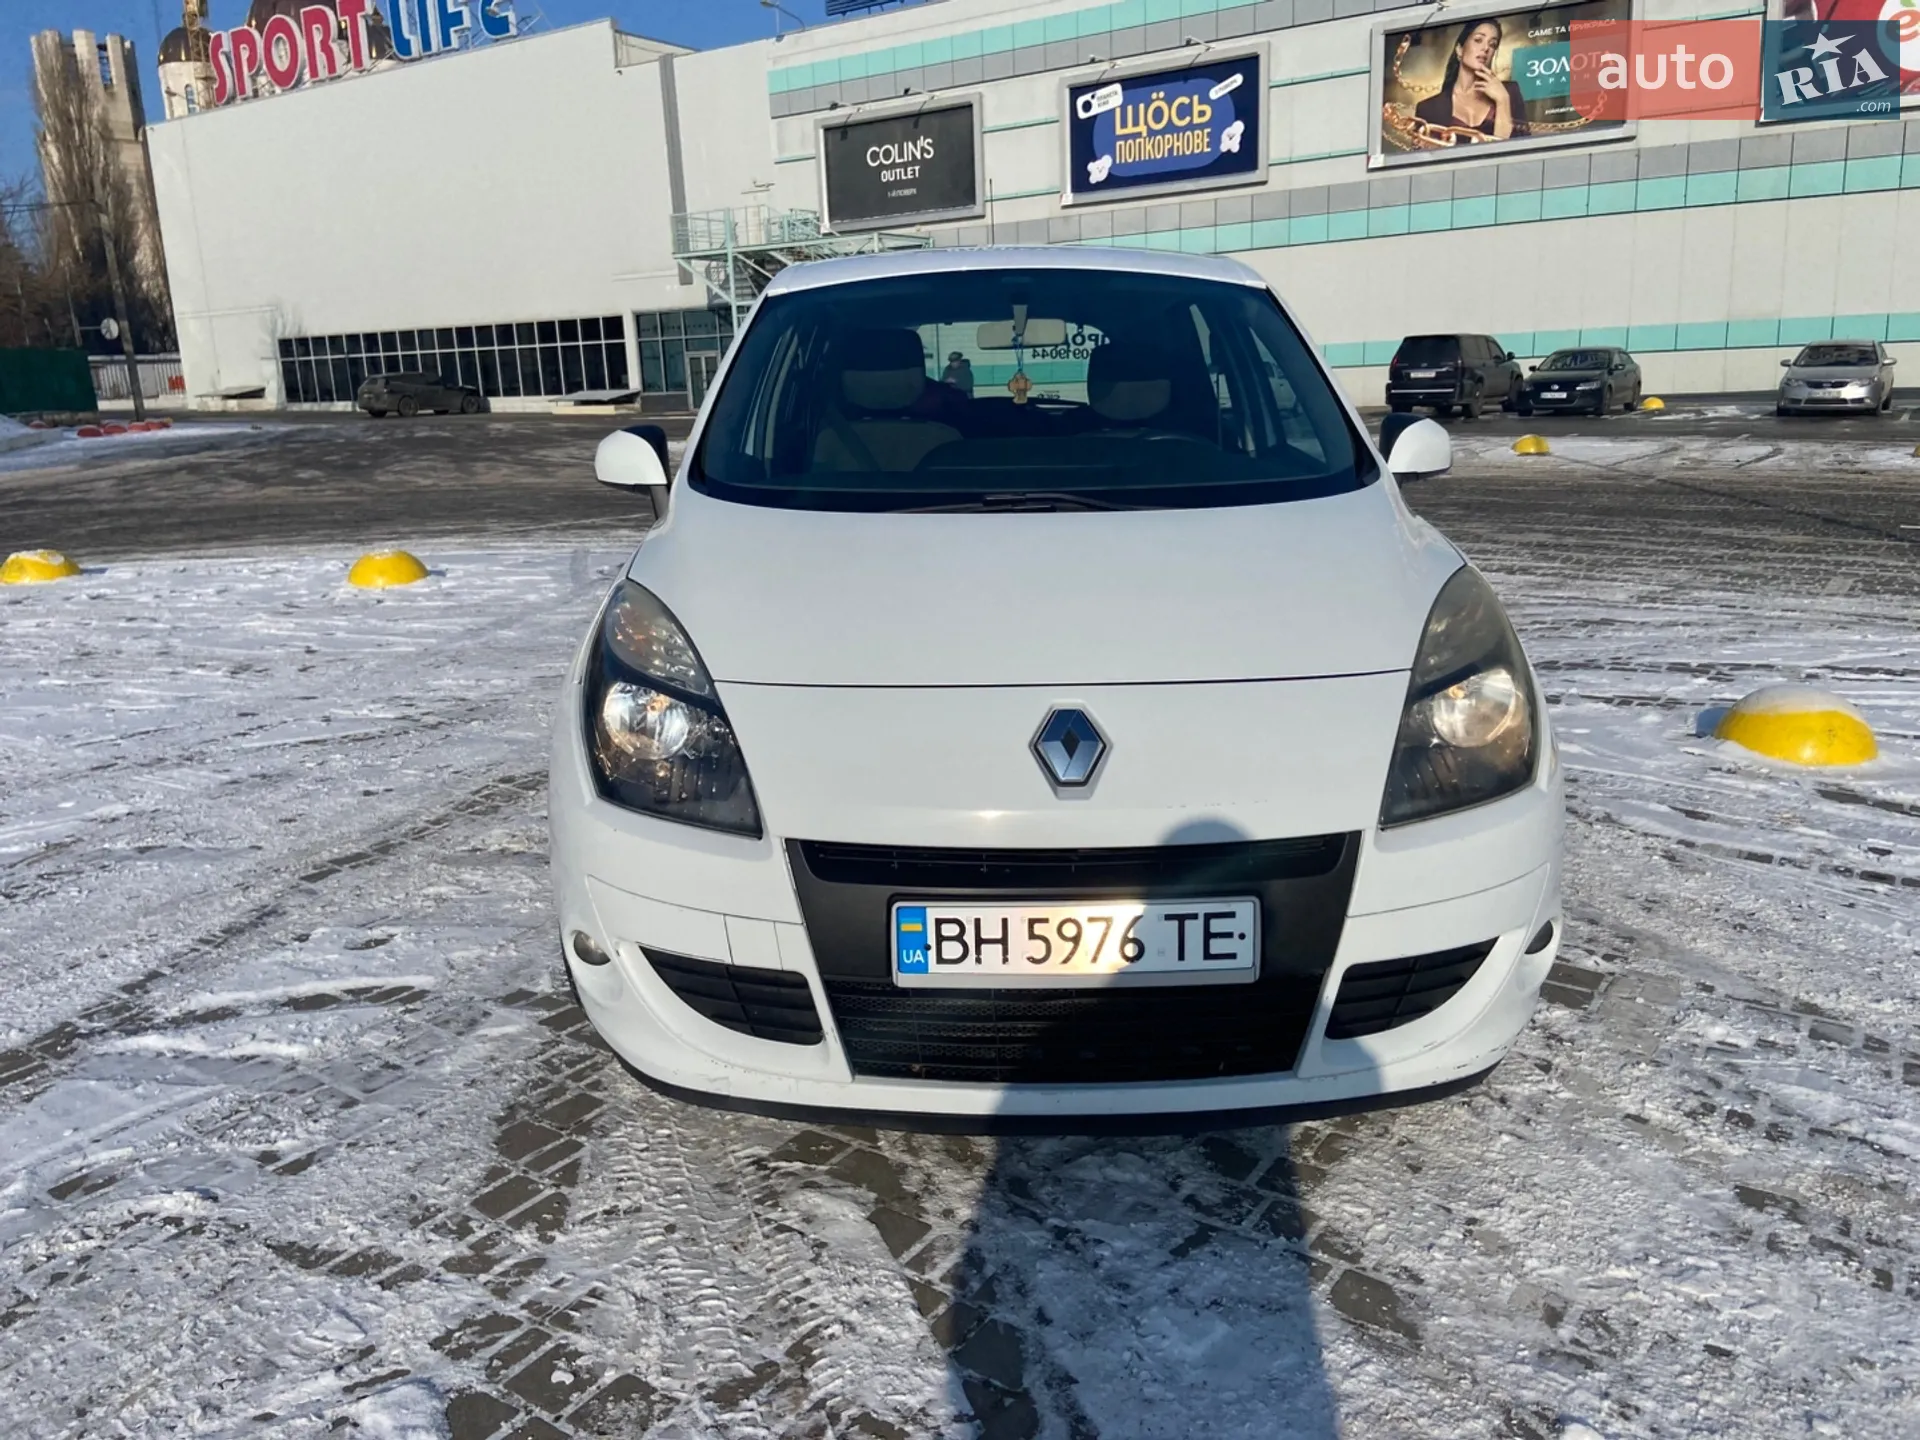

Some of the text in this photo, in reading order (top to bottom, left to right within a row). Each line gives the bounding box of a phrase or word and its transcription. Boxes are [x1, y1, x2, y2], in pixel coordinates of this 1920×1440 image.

[1528, 28, 1553, 38] САМЕ
[1555, 26, 1566, 34] ТА
[209, 0, 368, 105] SPORT
[866, 135, 934, 167] COLIN'S
[1116, 128, 1211, 164] ПОПКОРНОВЕ
[881, 165, 920, 182] OUTLET
[934, 911, 1238, 965] BH 5976 TE
[902, 949, 925, 964] UA
